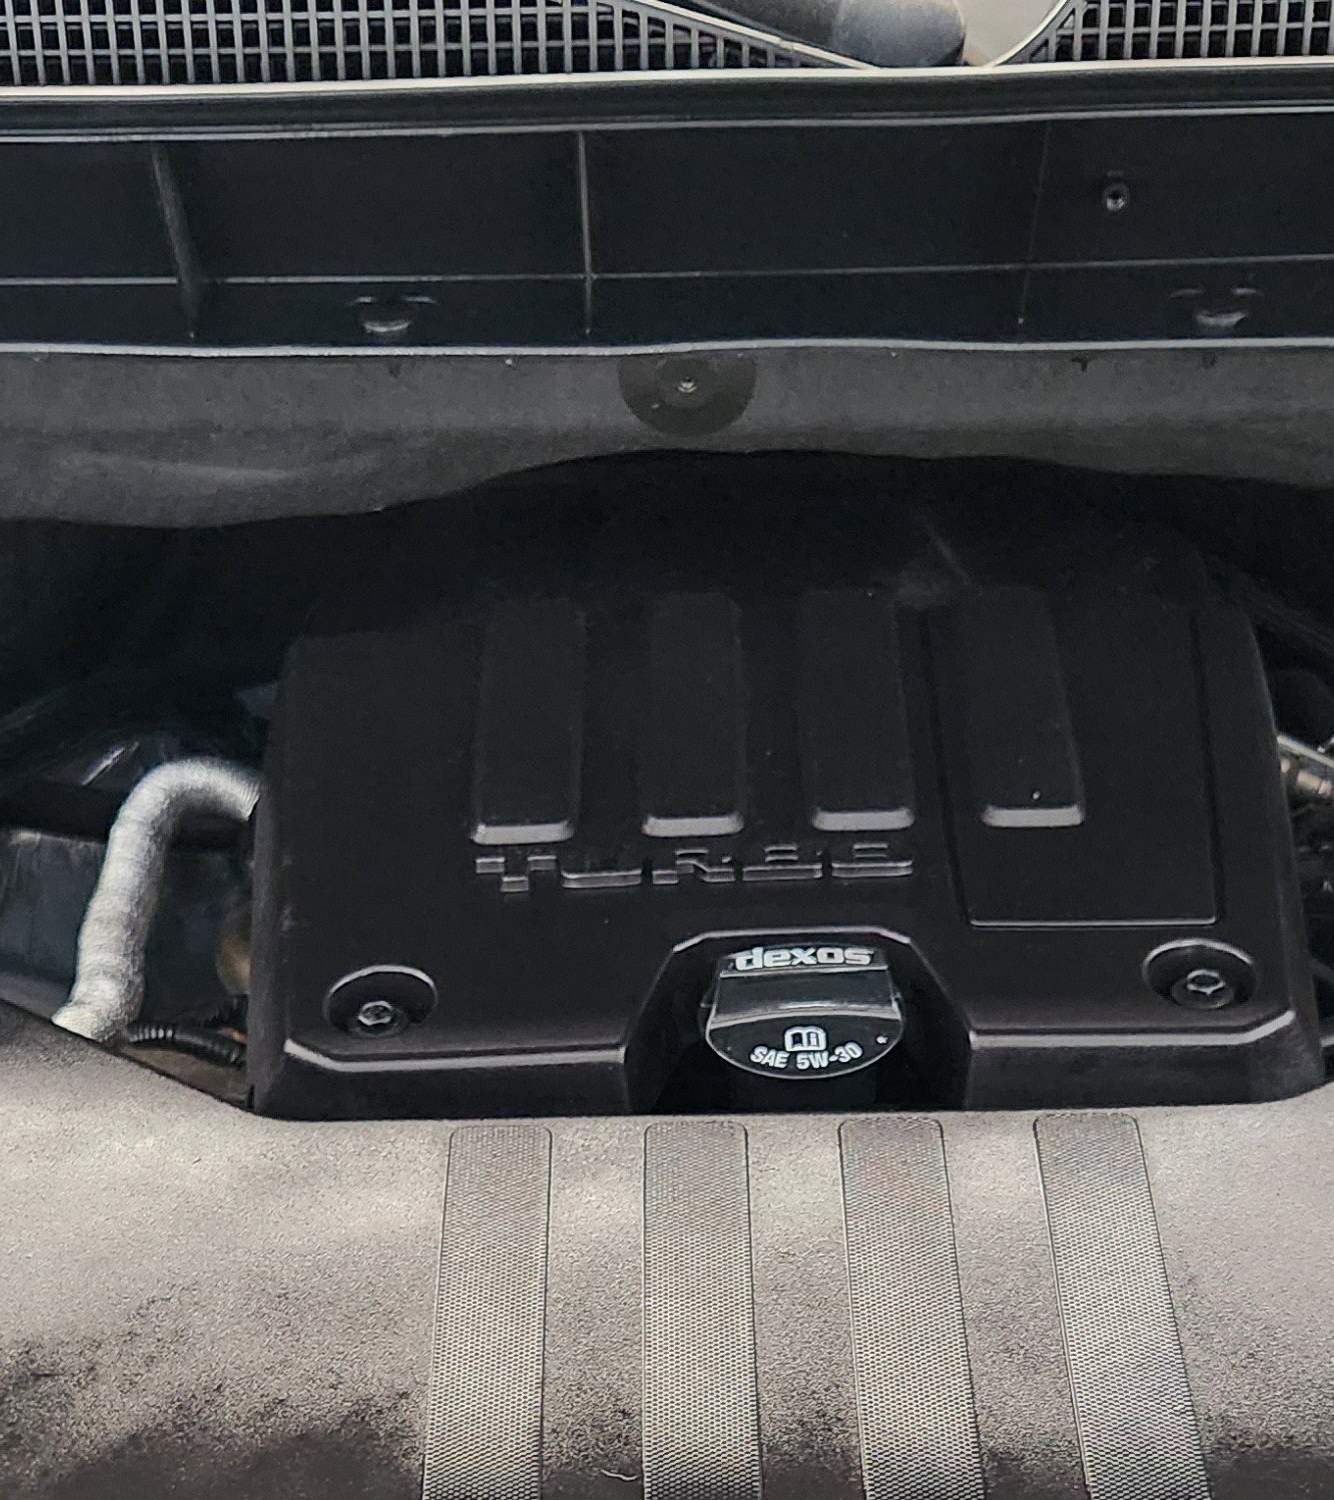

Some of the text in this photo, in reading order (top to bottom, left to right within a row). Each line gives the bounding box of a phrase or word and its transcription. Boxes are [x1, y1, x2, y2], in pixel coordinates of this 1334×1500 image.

[735, 946, 873, 971] dexos
[750, 1042, 863, 1070] SAE 5W-30
